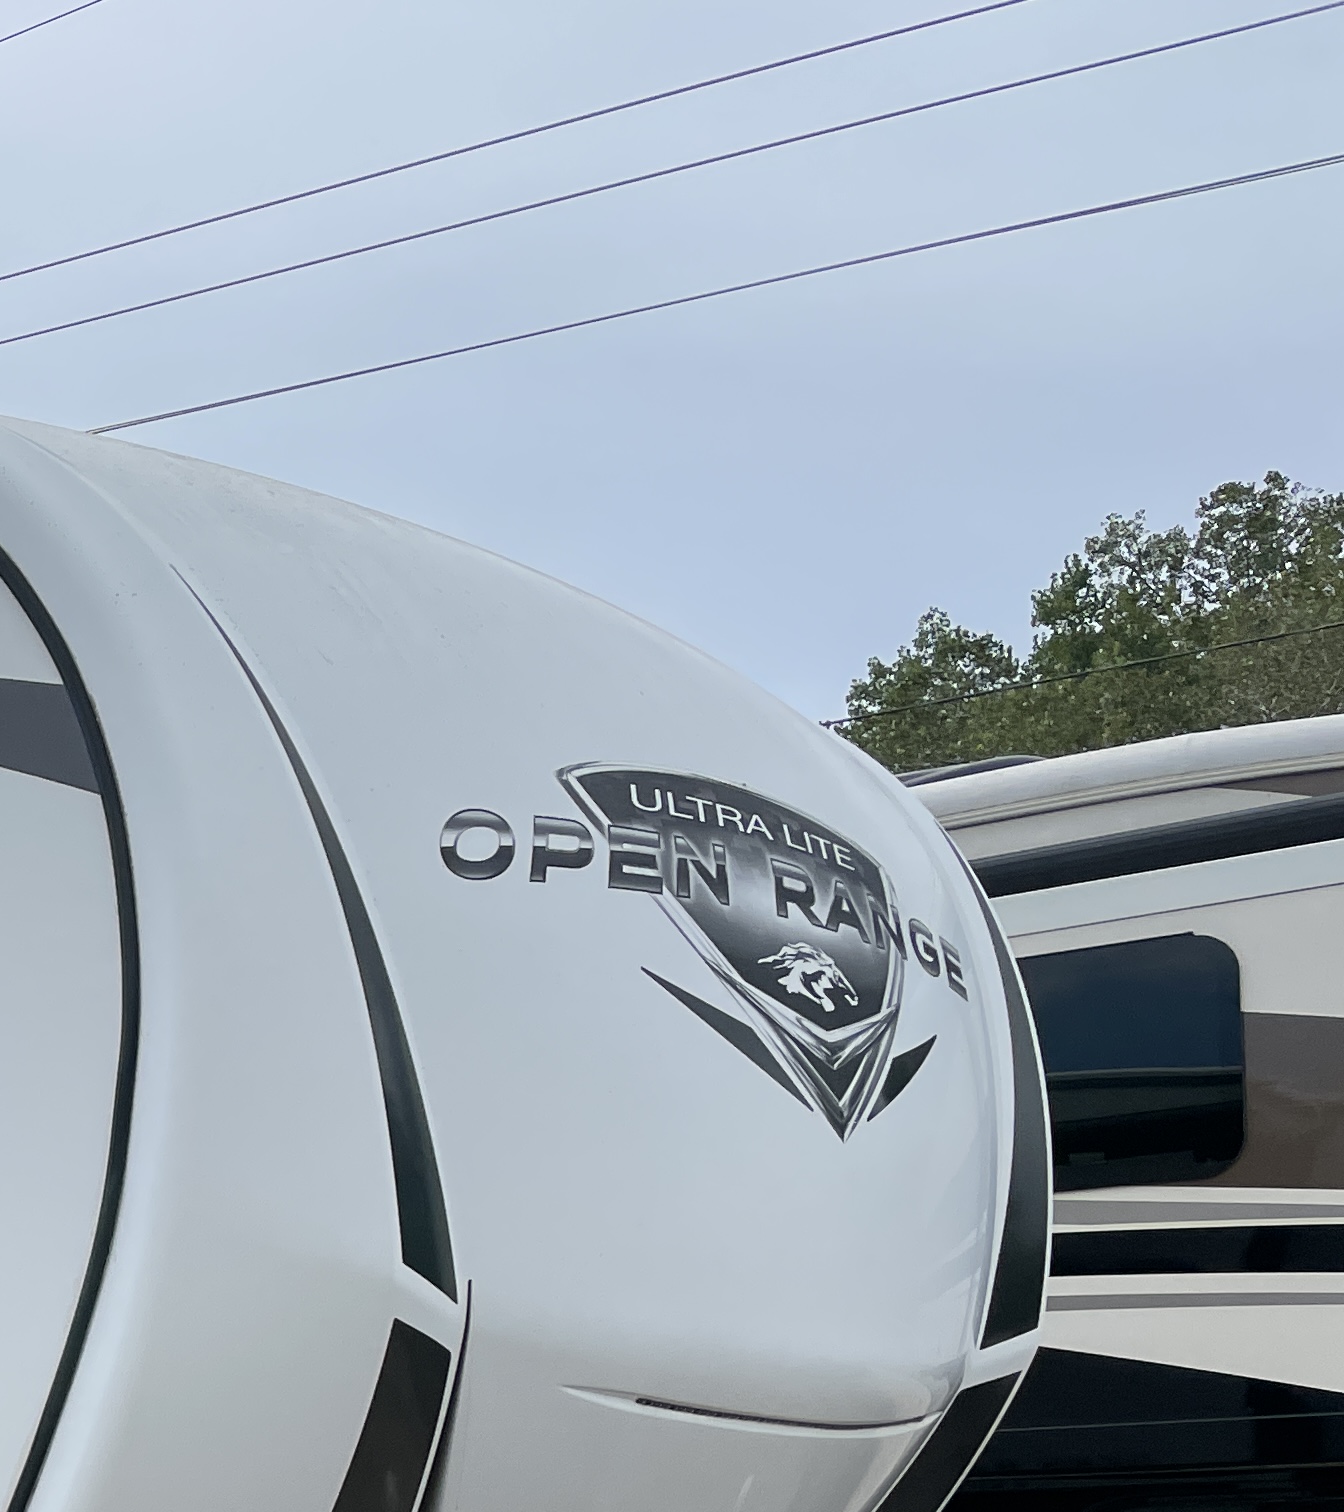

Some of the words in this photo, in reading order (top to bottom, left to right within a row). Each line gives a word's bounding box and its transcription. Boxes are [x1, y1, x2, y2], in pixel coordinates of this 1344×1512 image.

[629, 782, 776, 841] ULTRA
[782, 827, 856, 871] LITE
[439, 808, 730, 906] OPEN
[769, 857, 969, 1002] RANGE
